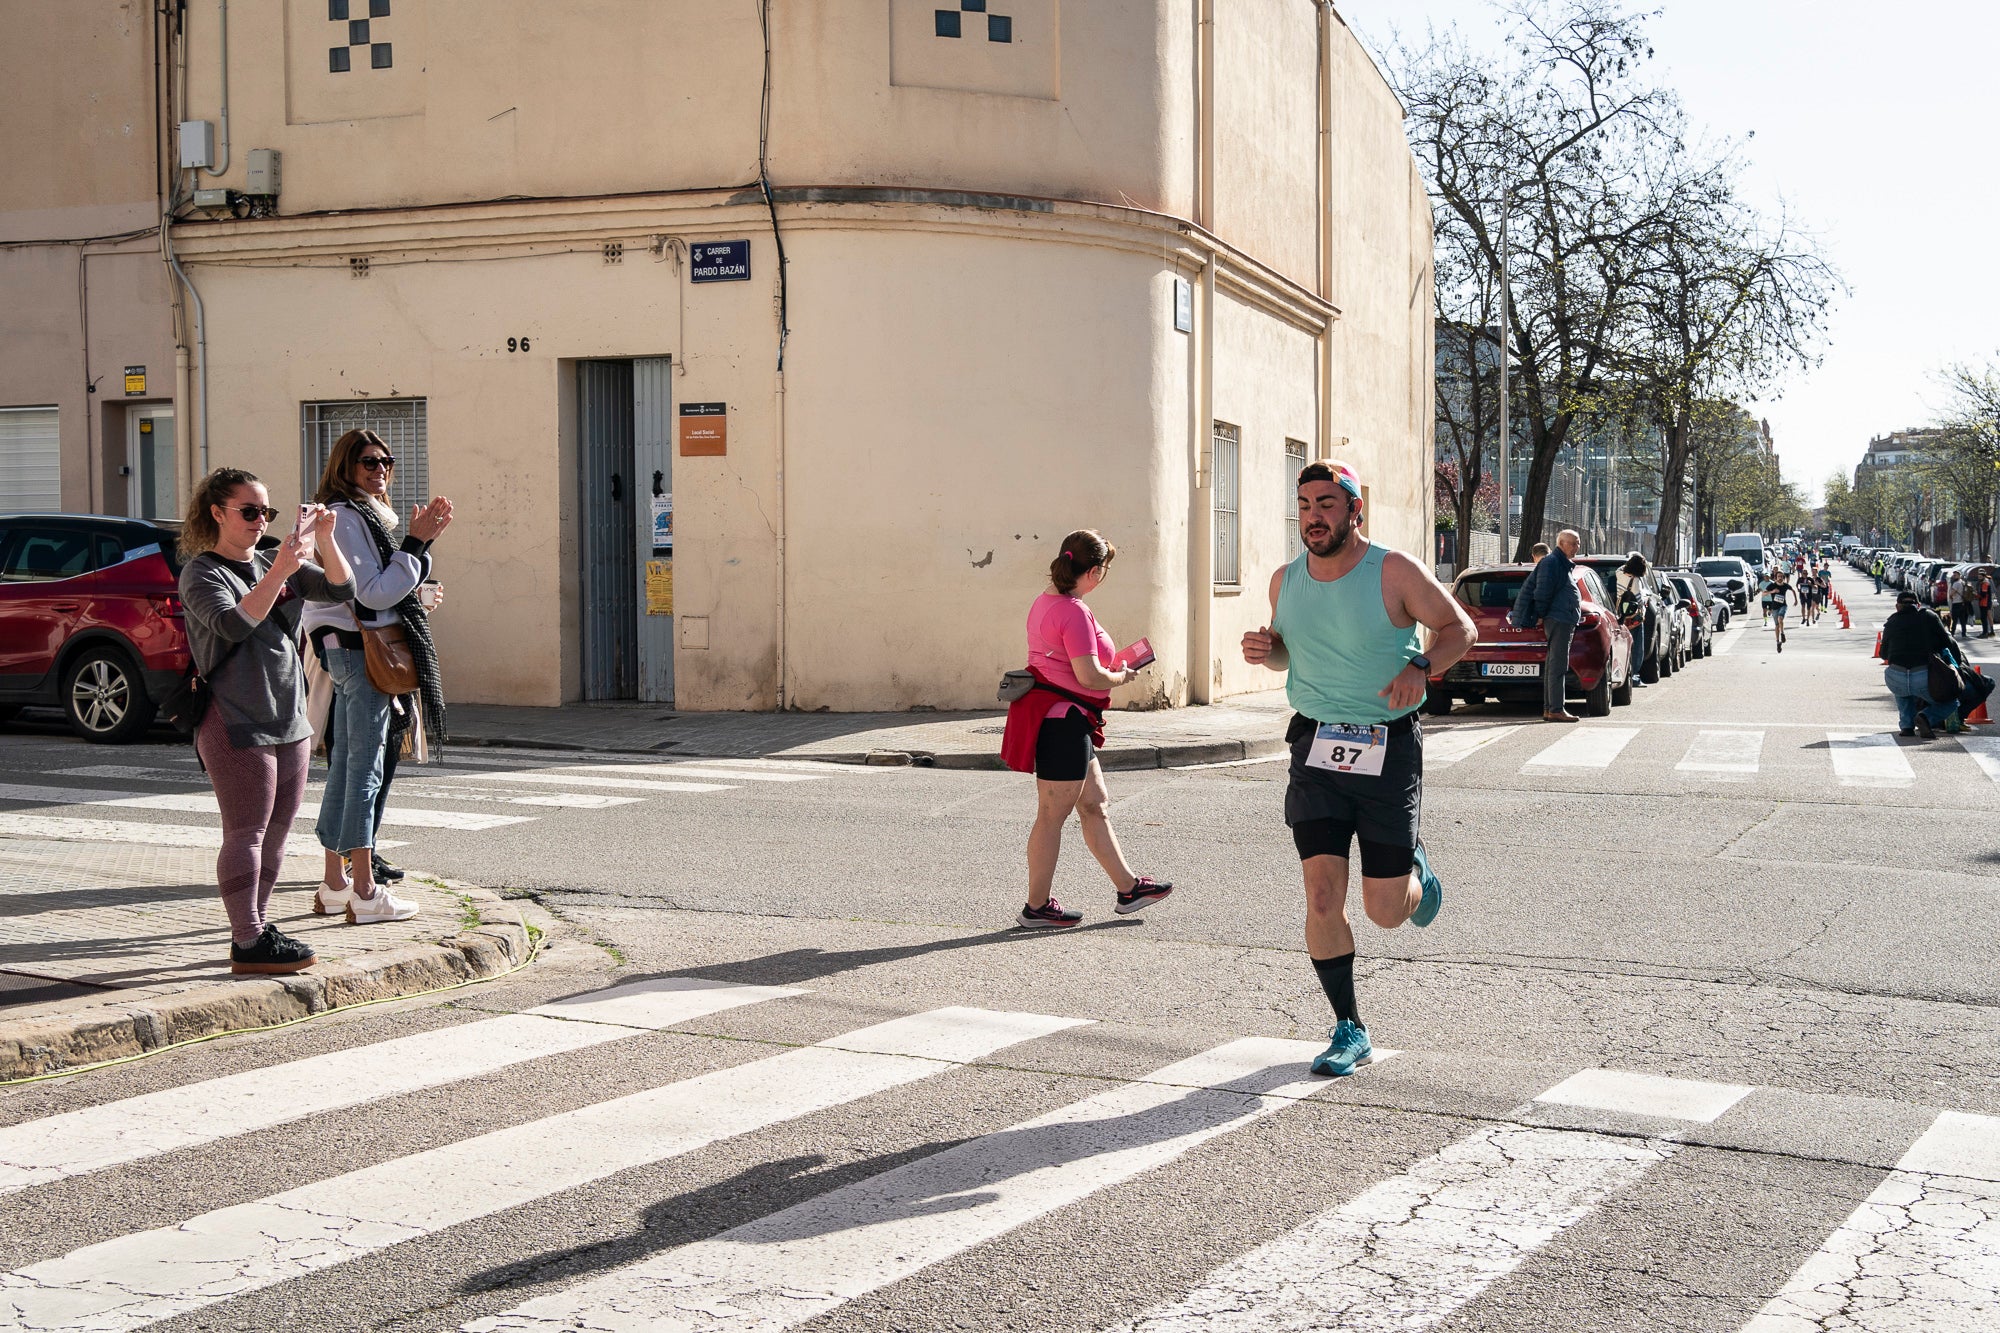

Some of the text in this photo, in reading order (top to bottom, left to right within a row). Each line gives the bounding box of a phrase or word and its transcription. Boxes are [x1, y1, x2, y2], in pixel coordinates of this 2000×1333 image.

[707, 247, 731, 255] CARRER
[694, 263, 745, 276] PARDO BAZÁN
[507, 336, 530, 353] 96
[1489, 665, 1537, 675] 4026 JST
[1330, 745, 1363, 765] 87
